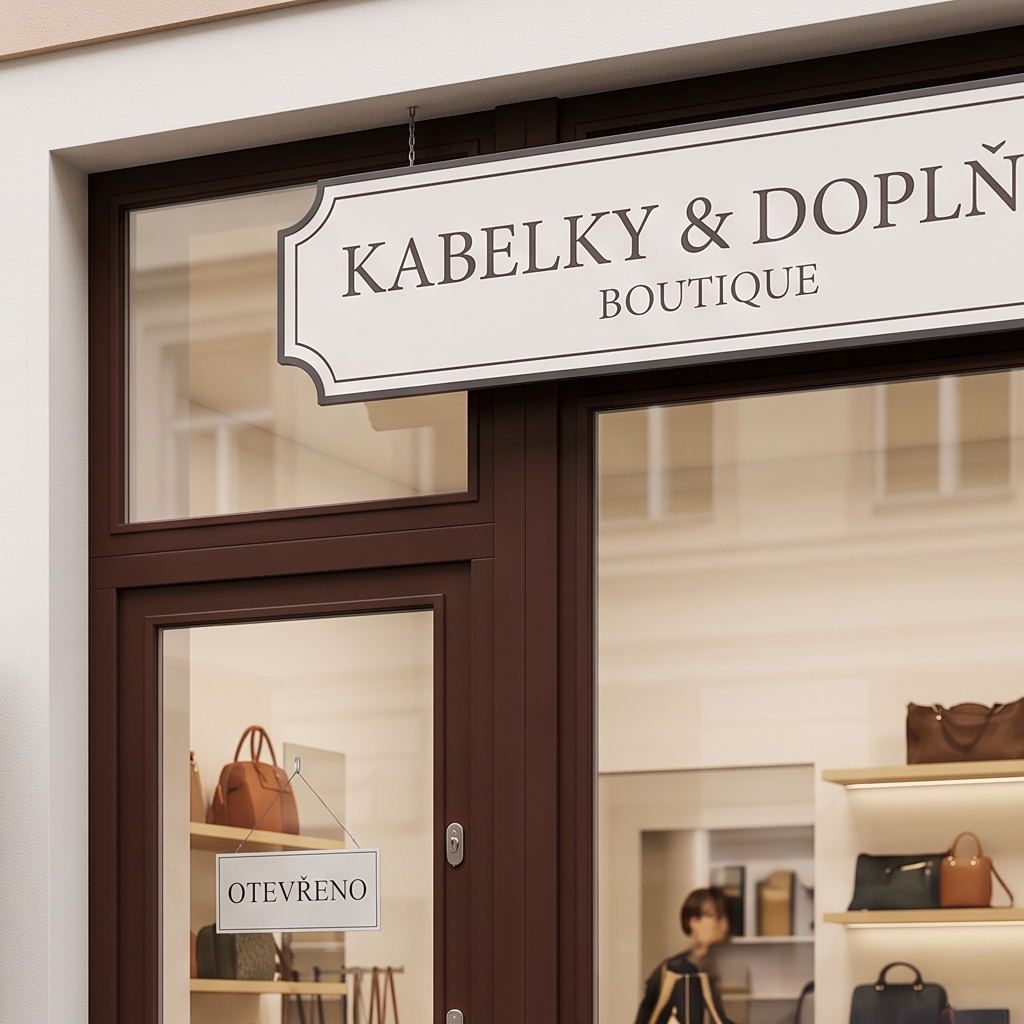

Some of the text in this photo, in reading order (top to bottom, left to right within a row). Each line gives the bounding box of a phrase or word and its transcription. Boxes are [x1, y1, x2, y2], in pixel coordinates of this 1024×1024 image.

[342, 140, 1024, 298] KABELKY & DOPLŇ
[598, 263, 820, 320] BOUTIQUE
[228, 875, 367, 904] OTEVŘENO
